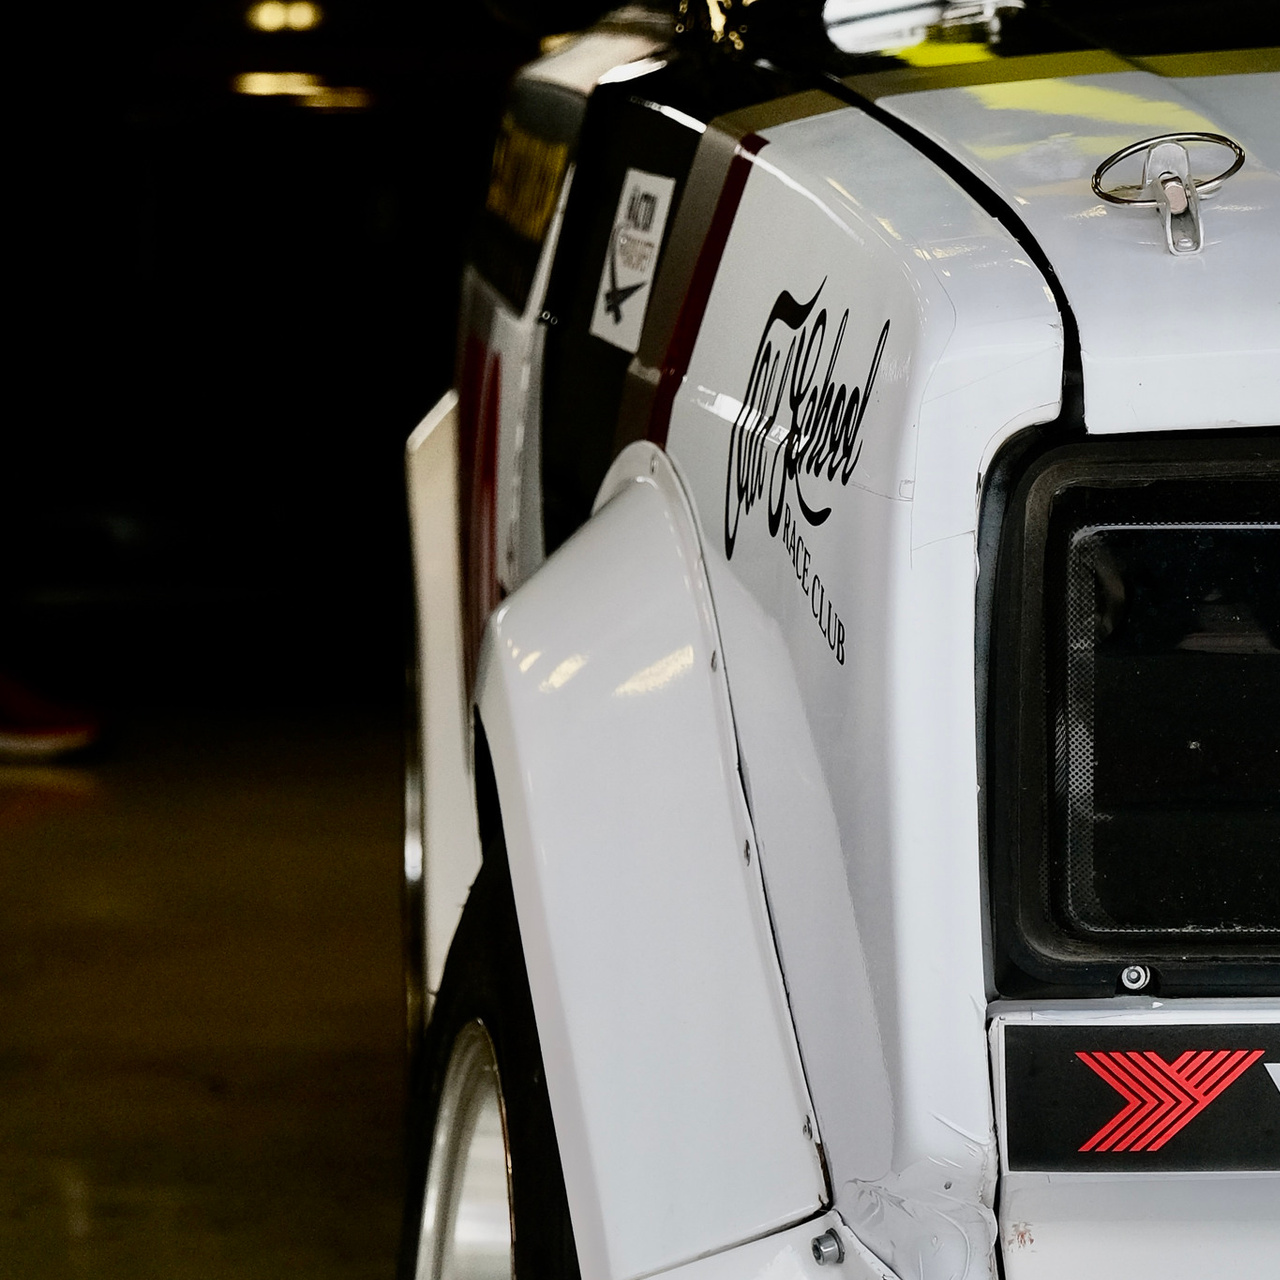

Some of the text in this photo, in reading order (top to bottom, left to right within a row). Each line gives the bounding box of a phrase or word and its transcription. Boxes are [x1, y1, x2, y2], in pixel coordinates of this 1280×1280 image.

[768, 308, 890, 538] School
[783, 503, 845, 665] RACE CLUB
